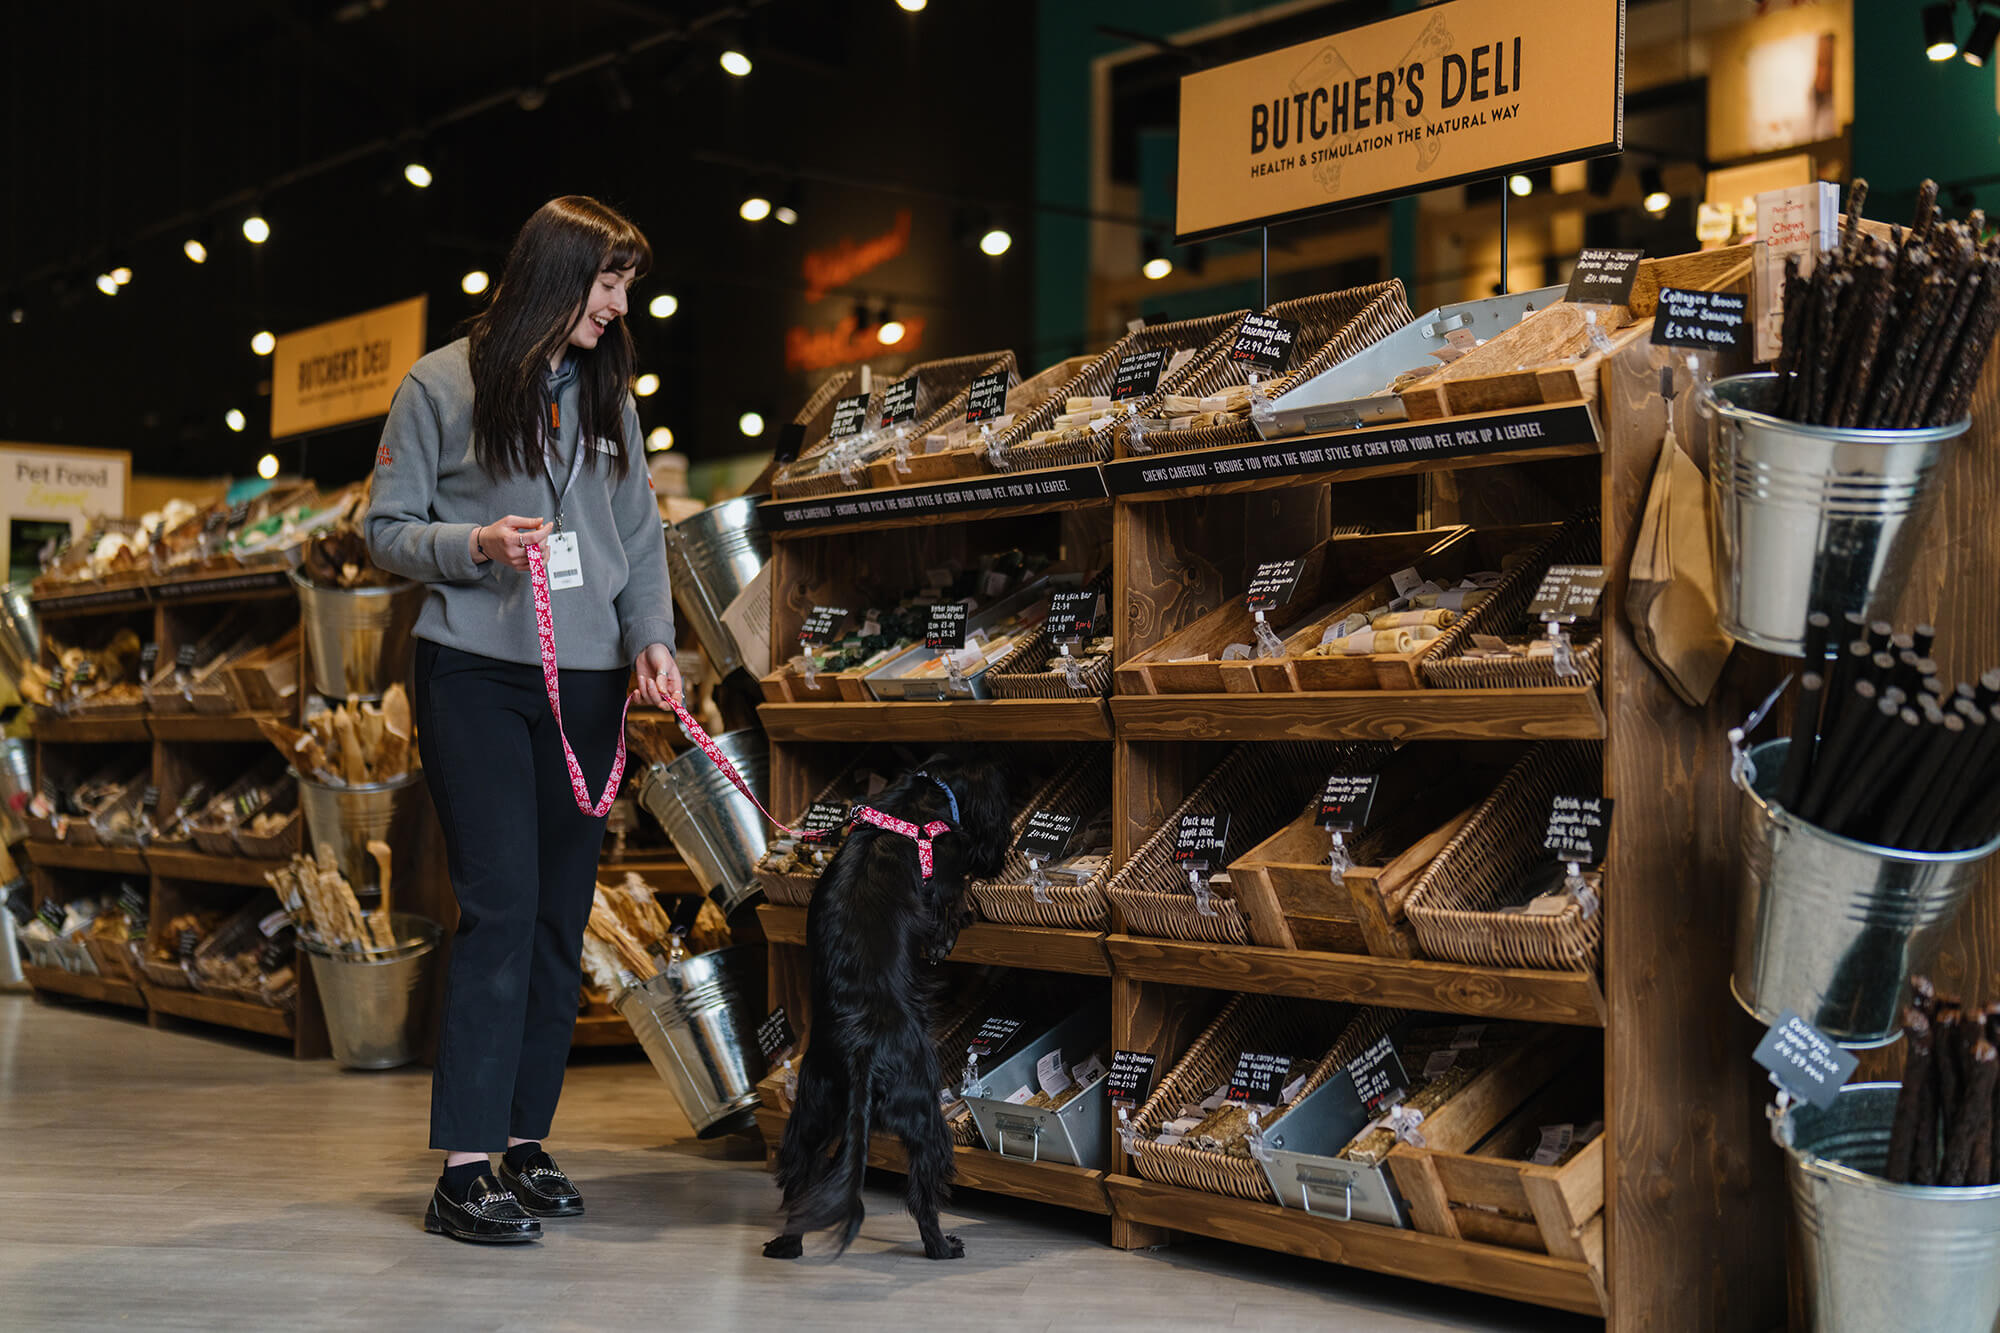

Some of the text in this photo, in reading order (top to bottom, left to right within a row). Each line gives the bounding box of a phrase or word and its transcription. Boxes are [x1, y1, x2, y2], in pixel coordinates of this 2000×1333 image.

[1251, 36, 1521, 154] BUTCHER'S DELI
[1251, 104, 1520, 178] HEALTH & STIMULATION THE NATURAL WAY
[1772, 222, 1805, 234] Chews
[1767, 231, 1810, 247] Carefully
[1660, 287, 1707, 308] Collagen
[1245, 313, 1279, 330] Lamb and
[1240, 324, 1275, 345] Rosemary
[1235, 337, 1280, 358] £2.99 each
[1142, 468, 1168, 483] CHEWS
[1168, 463, 1208, 480] CAREFULLY
[1213, 460, 1245, 475] ENSURE
[1244, 457, 1262, 471] YOU
[1262, 454, 1282, 469] PICK
[1281, 452, 1300, 466] THE
[1299, 449, 1325, 464] RIGHT
[1326, 445, 1351, 461] STYLE
[1352, 444, 1363, 458] OF
[1364, 441, 1389, 456] CHEW
[1390, 439, 1409, 453] FOR
[1409, 436, 1434, 451] YOUR
[1435, 433, 1456, 448] PET.
[1456, 431, 1479, 446] PICK
[1479, 428, 1493, 443] UP
[1495, 427, 1503, 441] A
[1502, 422, 1545, 440] LEAFLET.
[17, 464, 108, 488] Pet Food
[784, 510, 804, 522] CHEWS
[835, 503, 859, 516] ENSURE
[858, 502, 871, 513] YOU
[870, 500, 886, 512] PICK
[885, 498, 898, 511] THE
[897, 496, 916, 509] RIGHT
[915, 495, 934, 507] STYLE
[934, 493, 943, 505] OF
[943, 491, 962, 503] CHEW
[961, 489, 975, 501] FOR
[975, 488, 993, 500] YOUR
[993, 486, 1008, 499] PET.
[1007, 484, 1024, 497] PICK
[1023, 483, 1034, 495] UP
[1035, 482, 1042, 494] A
[1040, 479, 1070, 493] LEAFLET.
[1200, 816, 1215, 827] and
